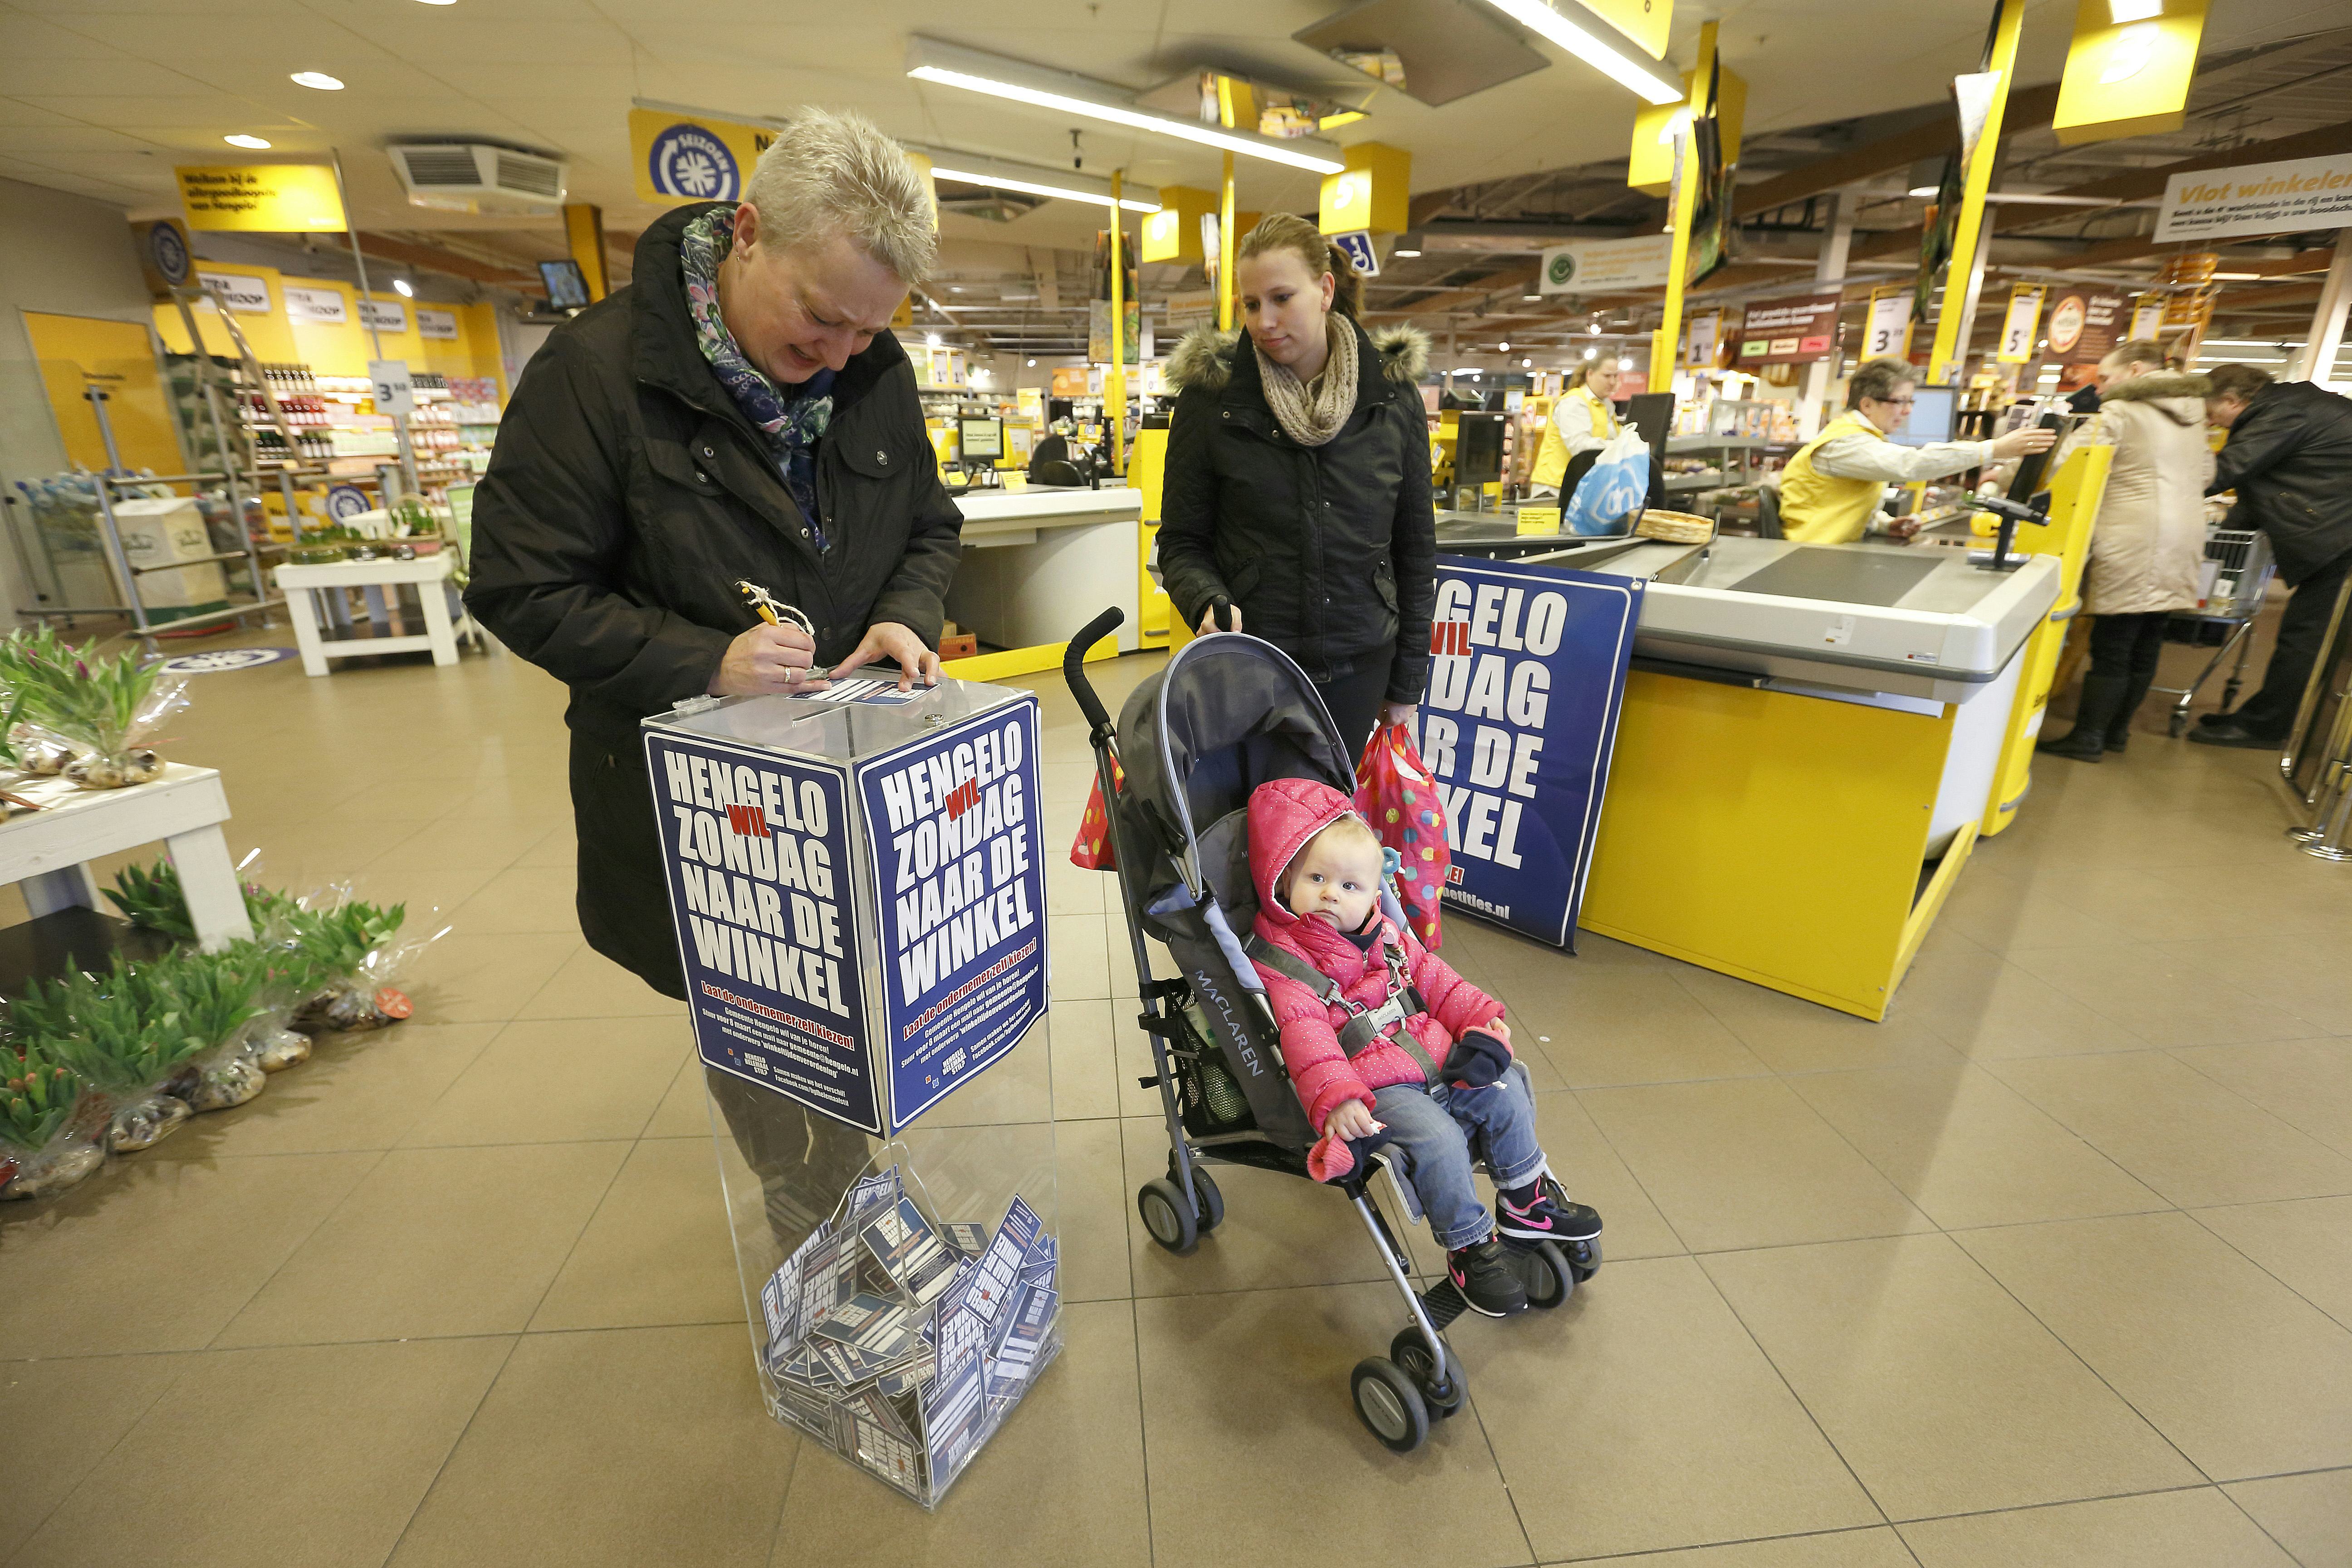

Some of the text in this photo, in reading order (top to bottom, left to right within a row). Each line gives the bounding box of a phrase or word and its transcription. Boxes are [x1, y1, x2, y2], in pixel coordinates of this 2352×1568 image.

[1334, 173, 1355, 209] 5
[2180, 182, 2233, 204] Vlot
[1876, 330, 1889, 352] 3
[2009, 330, 2019, 352] 5
[377, 383, 392, 402] 3
[1433, 578, 1568, 656] GELO
[1428, 653, 1551, 729] DAG
[880, 720, 1023, 834] HENGELO
[1469, 725, 1544, 799] DE
[663, 750, 829, 838] HENGELO
[725, 804, 772, 839] WIL
[945, 776, 982, 823] WIL
[673, 805, 835, 900] ZONDAG
[893, 773, 1024, 895] ZONDAG
[1437, 783, 1523, 870] KEL
[680, 861, 844, 959] NAAR DE
[896, 823, 1030, 952] NAAR DE
[688, 914, 850, 1019] WINKEL
[898, 876, 1034, 1008] WINKEL
[701, 980, 855, 1052] Laat de ondernemer zelf kiezen!
[901, 963, 1039, 1069] Stuur voor 8 maart een mail naar gemeente@hengelo.nl
[903, 936, 1037, 1042] Laat de ondernemer zelf kiezen!
[924, 968, 1020, 1039] Gemeente Hengelo wil van je horen!
[702, 1008, 716, 1019] Stuur
[716, 1014, 730, 1025] voor
[734, 1021, 752, 1034] maart
[752, 1028, 763, 1037] een
[763, 1033, 776, 1043] mail
[776, 1038, 789, 1048] naar
[789, 1042, 859, 1077] gemeente@hengelo.nl
[722, 1026, 733, 1036] met
[733, 1030, 761, 1047] onderwerp
[725, 1006, 829, 1055] Gemeente Hengelo wil van je horen!
[920, 1053, 931, 1064] met
[931, 1031, 960, 1056] onderwerp
[970, 1039, 987, 1054] Samen
[986, 1026, 1002, 1042] maken
[1002, 1019, 1009, 1029] we
[1008, 1014, 1017, 1024] het
[1195, 969, 1264, 1077] MACLAREN
[744, 1052, 766, 1064] HENGELO
[744, 1058, 769, 1071] HELEMAAL
[754, 1066, 768, 1076] STIL?
[773, 1066, 790, 1078] Samen
[790, 1072, 807, 1083] maken
[807, 1078, 815, 1087] we
[814, 1080, 823, 1089] het
[942, 1046, 965, 1068] HENGELO
[942, 1052, 967, 1076] HELEMAAL
[951, 1060, 966, 1075] STIL?
